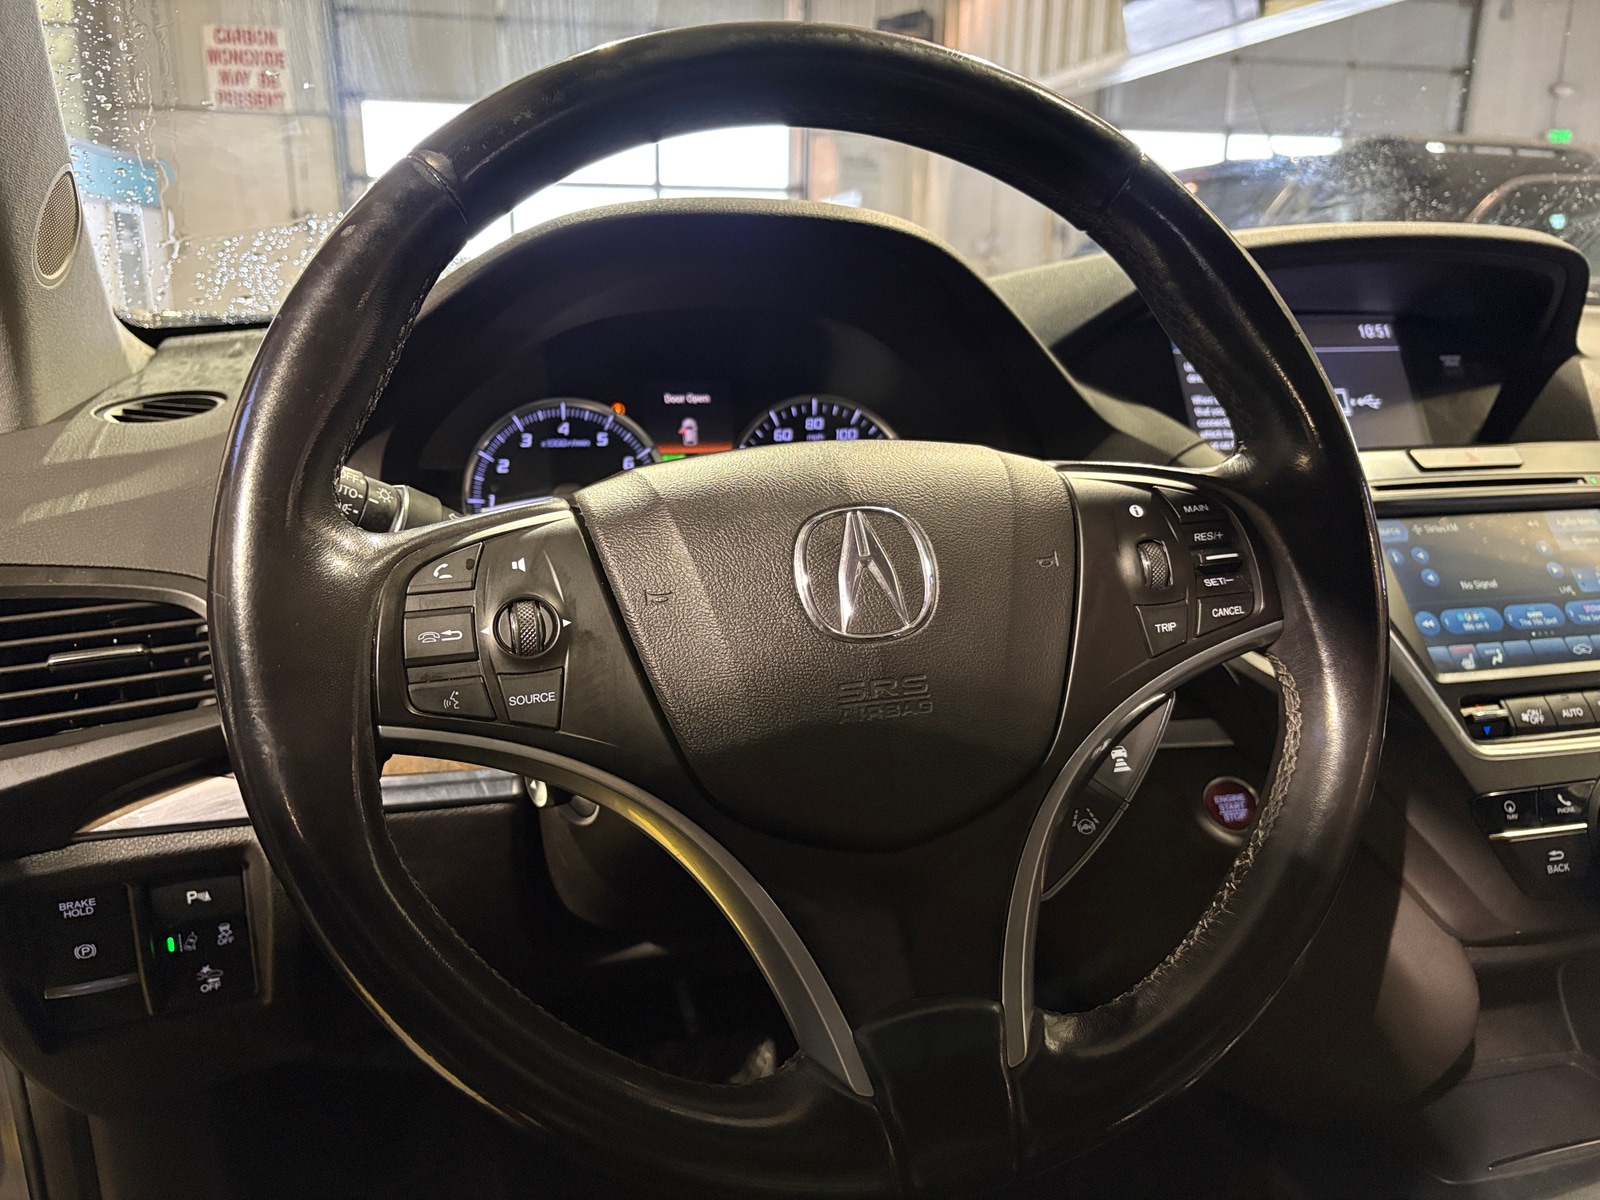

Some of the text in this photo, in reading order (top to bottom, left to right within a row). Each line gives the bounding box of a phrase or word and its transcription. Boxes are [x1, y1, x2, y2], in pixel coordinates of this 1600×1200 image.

[213, 26, 278, 46] CARBON
[207, 47, 285, 69] MONOXIDE
[219, 69, 250, 87] MAY
[217, 88, 286, 108] PRESENT
[1357, 323, 1392, 339] 10:51
[663, 391, 711, 405] Door Open
[557, 421, 570, 436] 4
[805, 417, 825, 431] 80
[520, 432, 533, 448] 3
[596, 432, 609, 447] 5
[773, 428, 794, 442] 60
[835, 428, 859, 440] 100
[496, 458, 510, 474] 2
[623, 456, 636, 470] 6
[1183, 503, 1209, 514] MAIN
[1194, 531, 1223, 542] RES/+
[1212, 605, 1245, 618] CANCEL
[1154, 621, 1177, 634] TRIP
[836, 674, 931, 700] SRS
[508, 691, 556, 706] SOURCE
[836, 702, 933, 725] AIRBAG
[1562, 707, 1584, 718] AUTO
[1557, 806, 1576, 814] PHONE
[1546, 863, 1570, 875] BACK
[58, 897, 97, 912] BRAKE
[63, 906, 94, 919] HOLD
[217, 936, 235, 947] OFF
[200, 981, 222, 994] OFF
